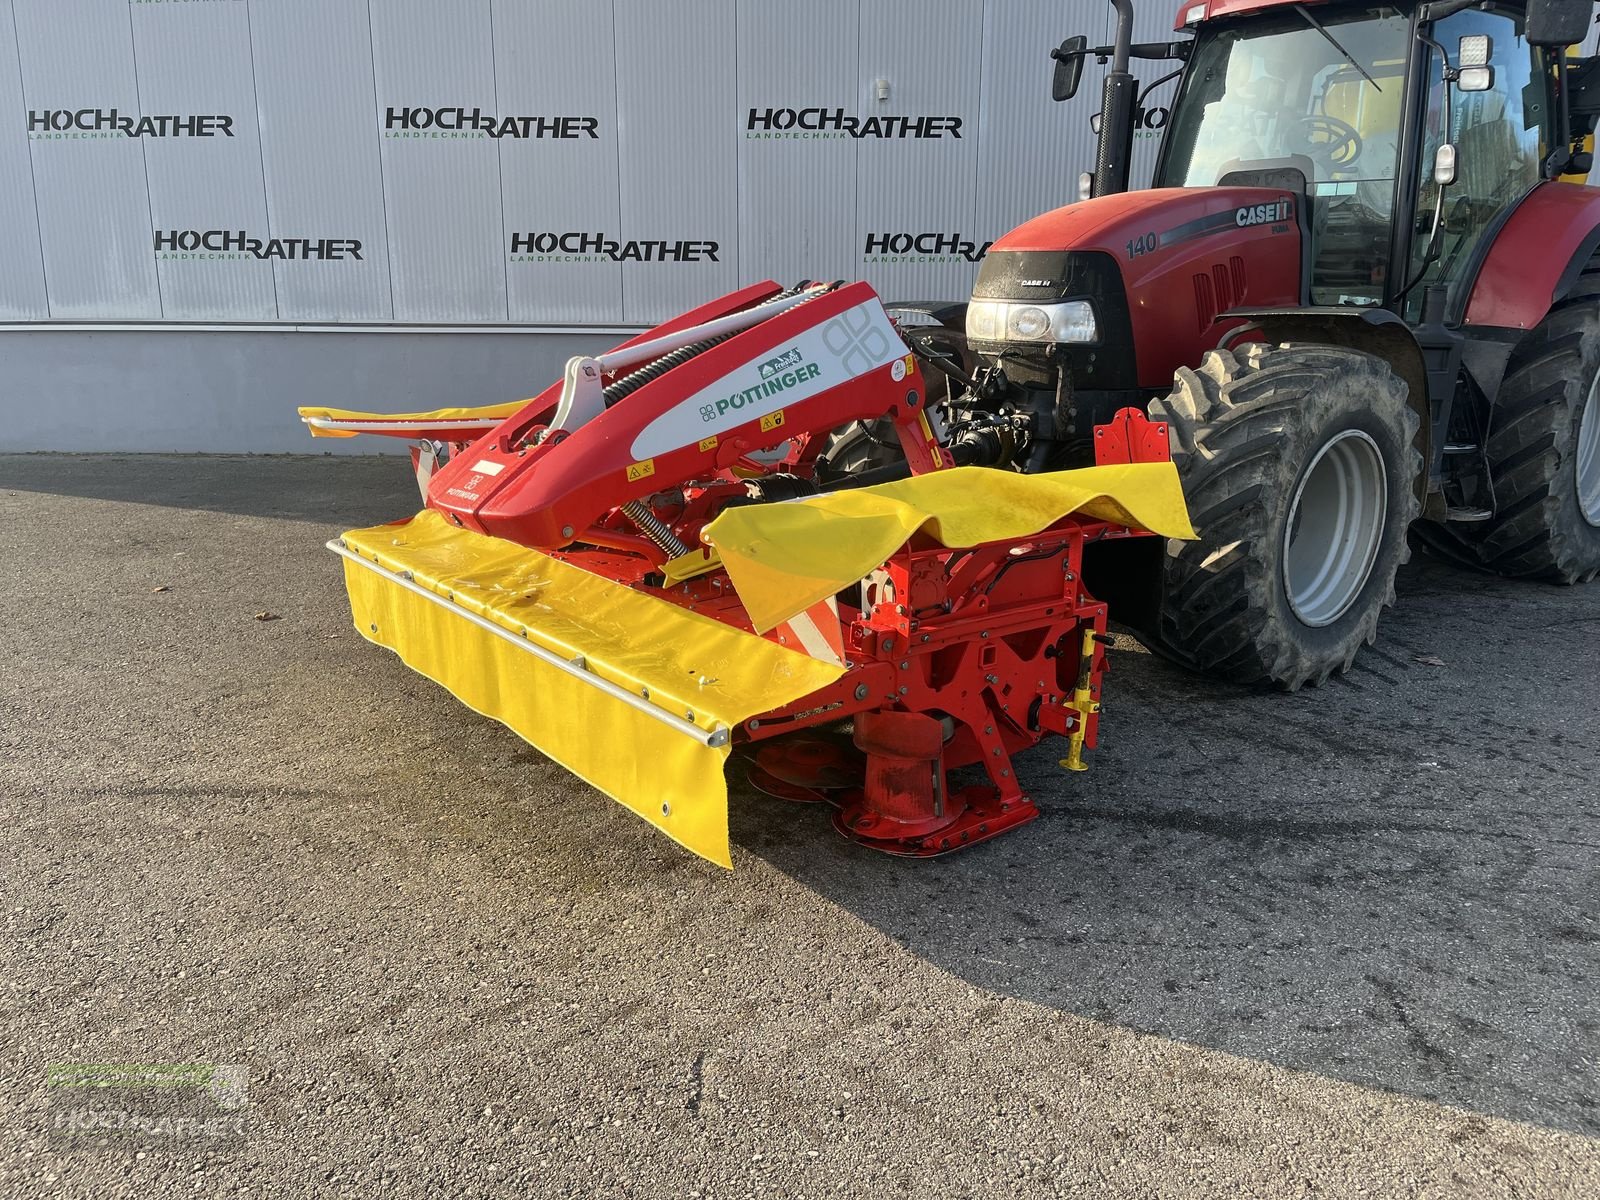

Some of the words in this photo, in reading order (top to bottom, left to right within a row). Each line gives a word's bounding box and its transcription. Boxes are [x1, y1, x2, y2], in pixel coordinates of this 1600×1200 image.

[28, 108, 234, 138] HOCHRATHER
[28, 132, 124, 140] LANDTECHNIK
[385, 107, 599, 139] HOCHRATHER
[385, 131, 485, 139] LANDTECHNIK
[746, 132, 847, 140] LANDTECHNIK
[747, 108, 962, 139] HOCHRATHER
[1236, 204, 1275, 227] CASE
[154, 230, 363, 260] HOCHRATHER
[154, 253, 251, 261] LANDTECHNIK
[511, 232, 720, 262] HOCHRATHER
[1126, 231, 1157, 260] 140
[510, 255, 609, 263] LANDTECHNIK
